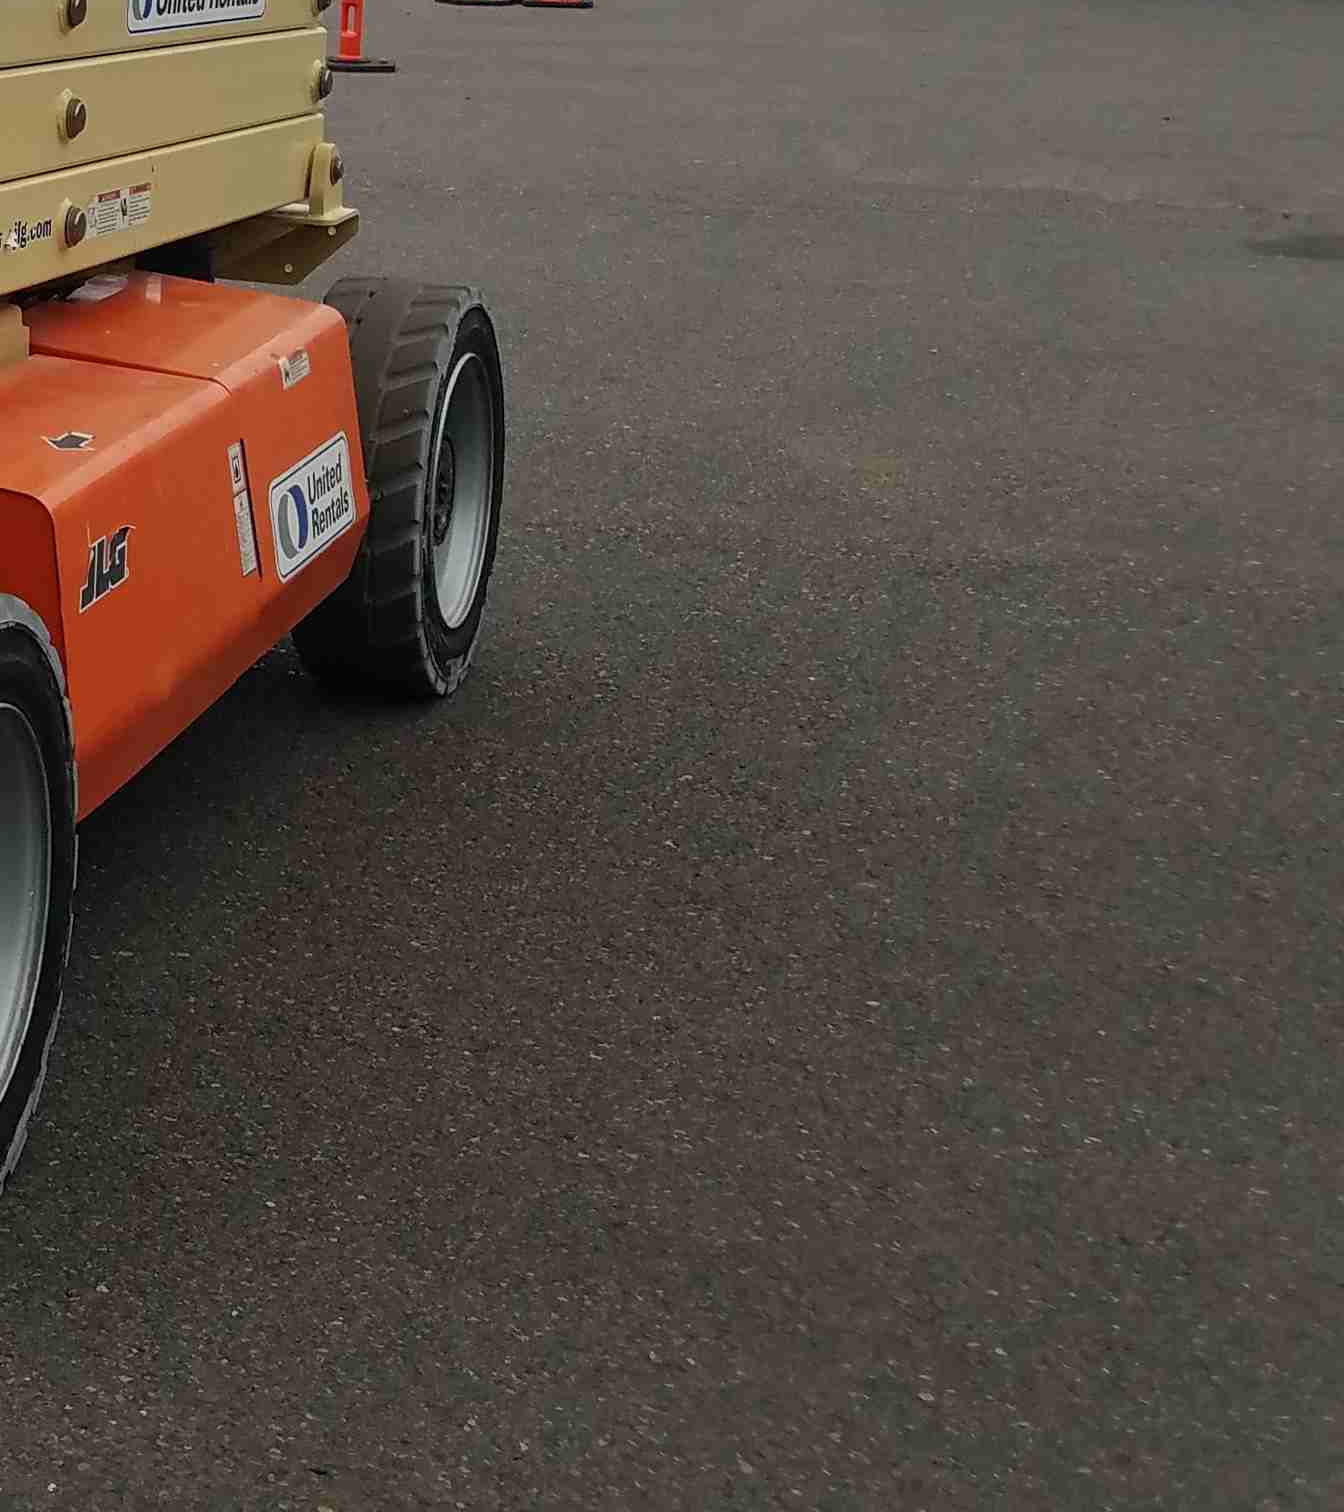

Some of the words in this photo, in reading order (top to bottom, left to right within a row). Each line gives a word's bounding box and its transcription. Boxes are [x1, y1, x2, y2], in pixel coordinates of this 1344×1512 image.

[307, 452, 343, 505] United
[311, 486, 350, 540] Rentals
[78, 524, 133, 613] JLG
